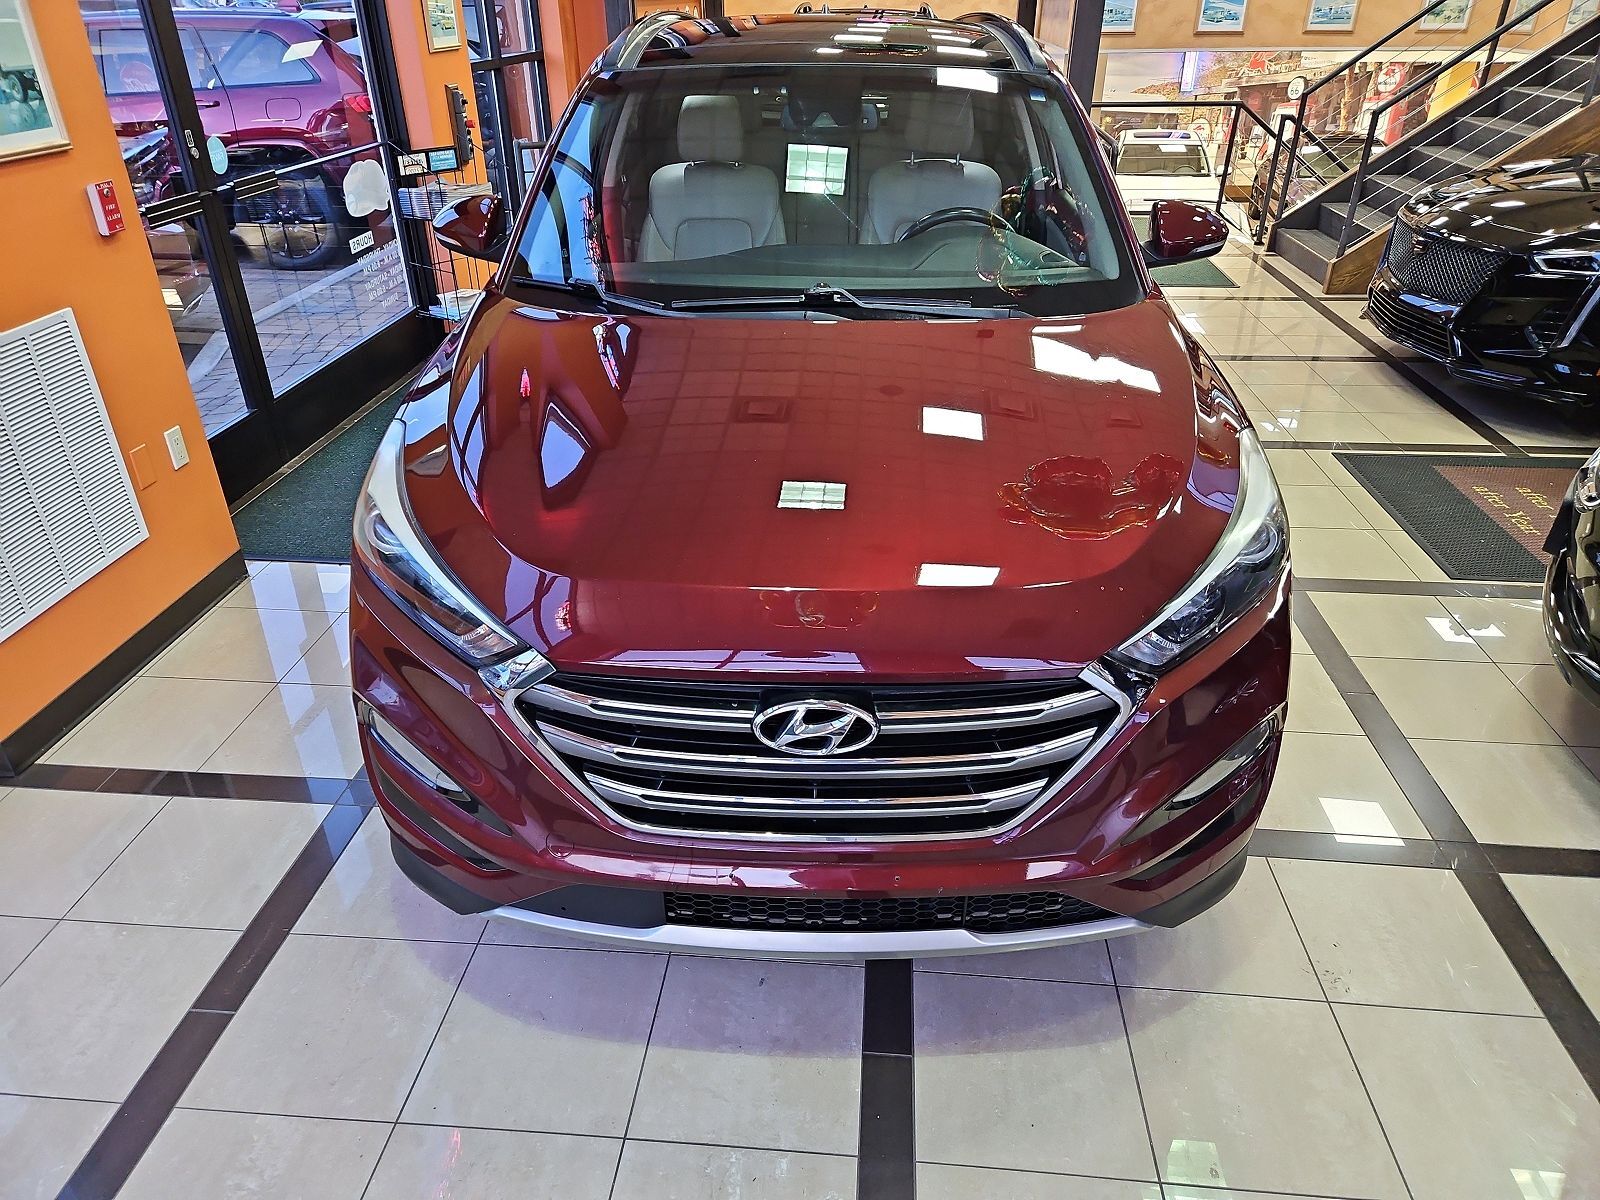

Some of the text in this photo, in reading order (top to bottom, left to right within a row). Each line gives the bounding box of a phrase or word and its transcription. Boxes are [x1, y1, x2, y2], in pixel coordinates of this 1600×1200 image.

[1472, 486, 1541, 536] after Year
[1515, 487, 1554, 510] after
